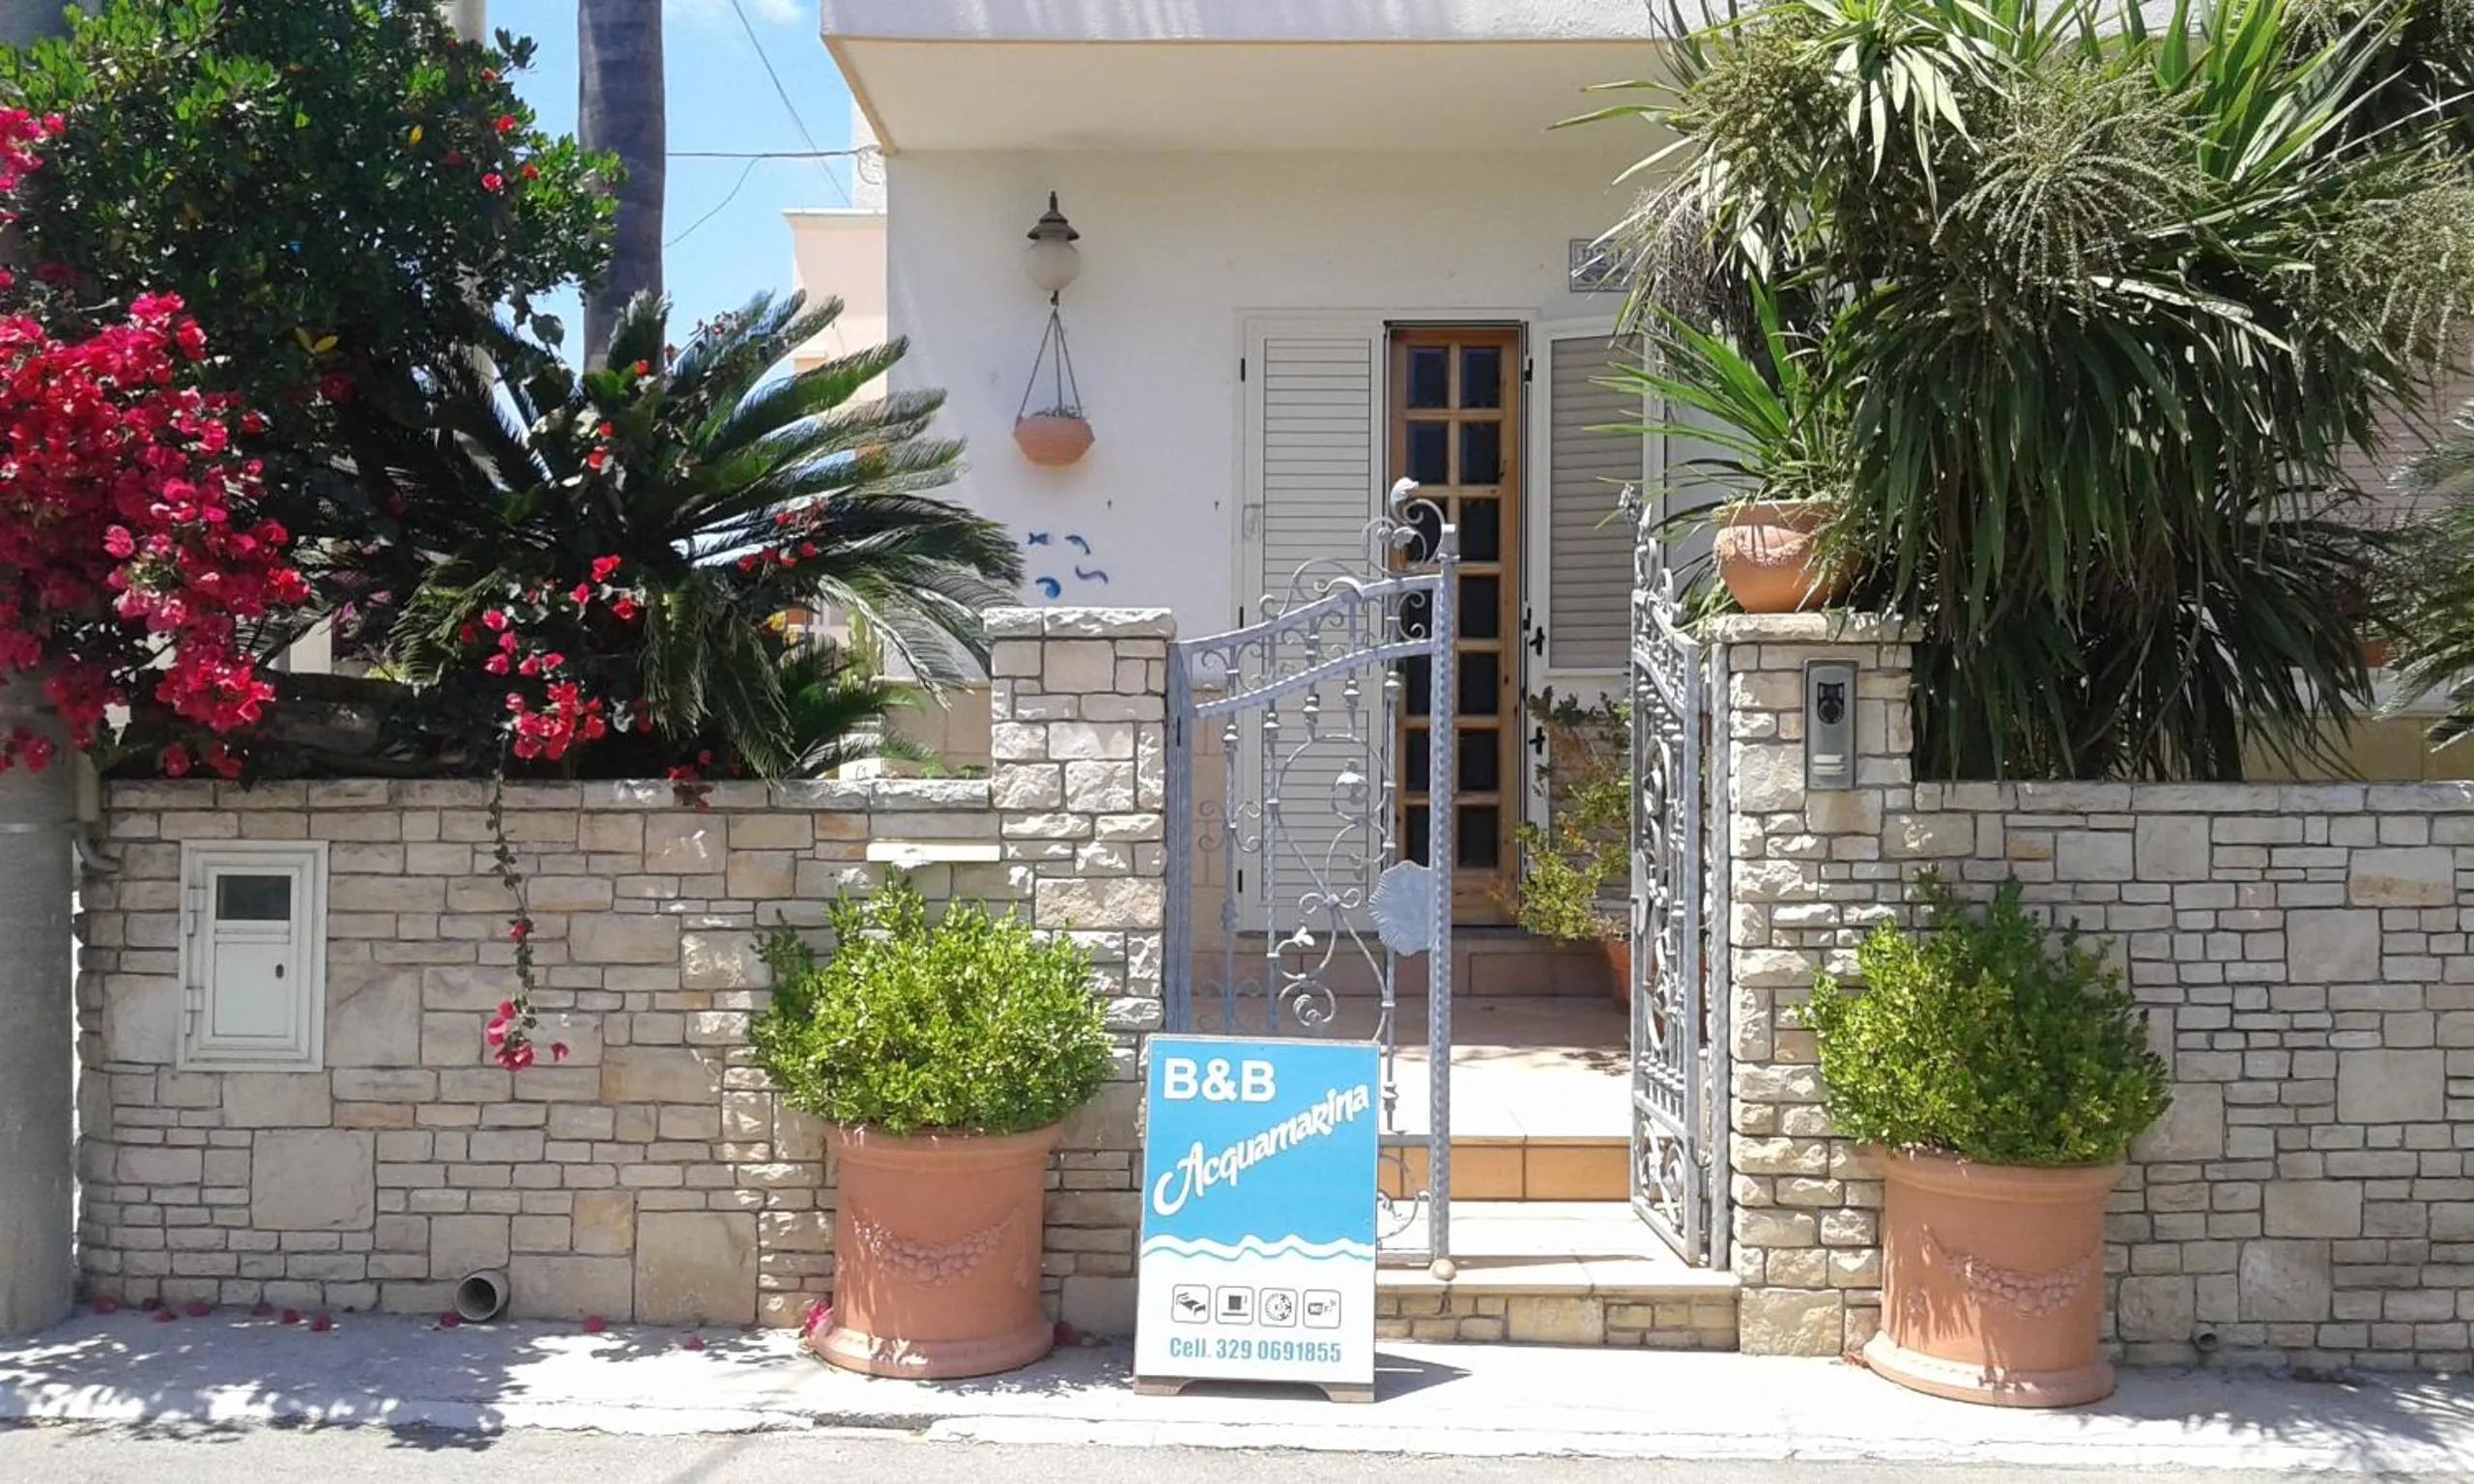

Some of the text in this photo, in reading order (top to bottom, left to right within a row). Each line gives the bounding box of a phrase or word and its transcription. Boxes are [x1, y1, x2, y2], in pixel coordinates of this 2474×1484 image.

[1164, 1059, 1275, 1101] B&B
[1170, 1337, 1341, 1362] Cell. 329 0691855
